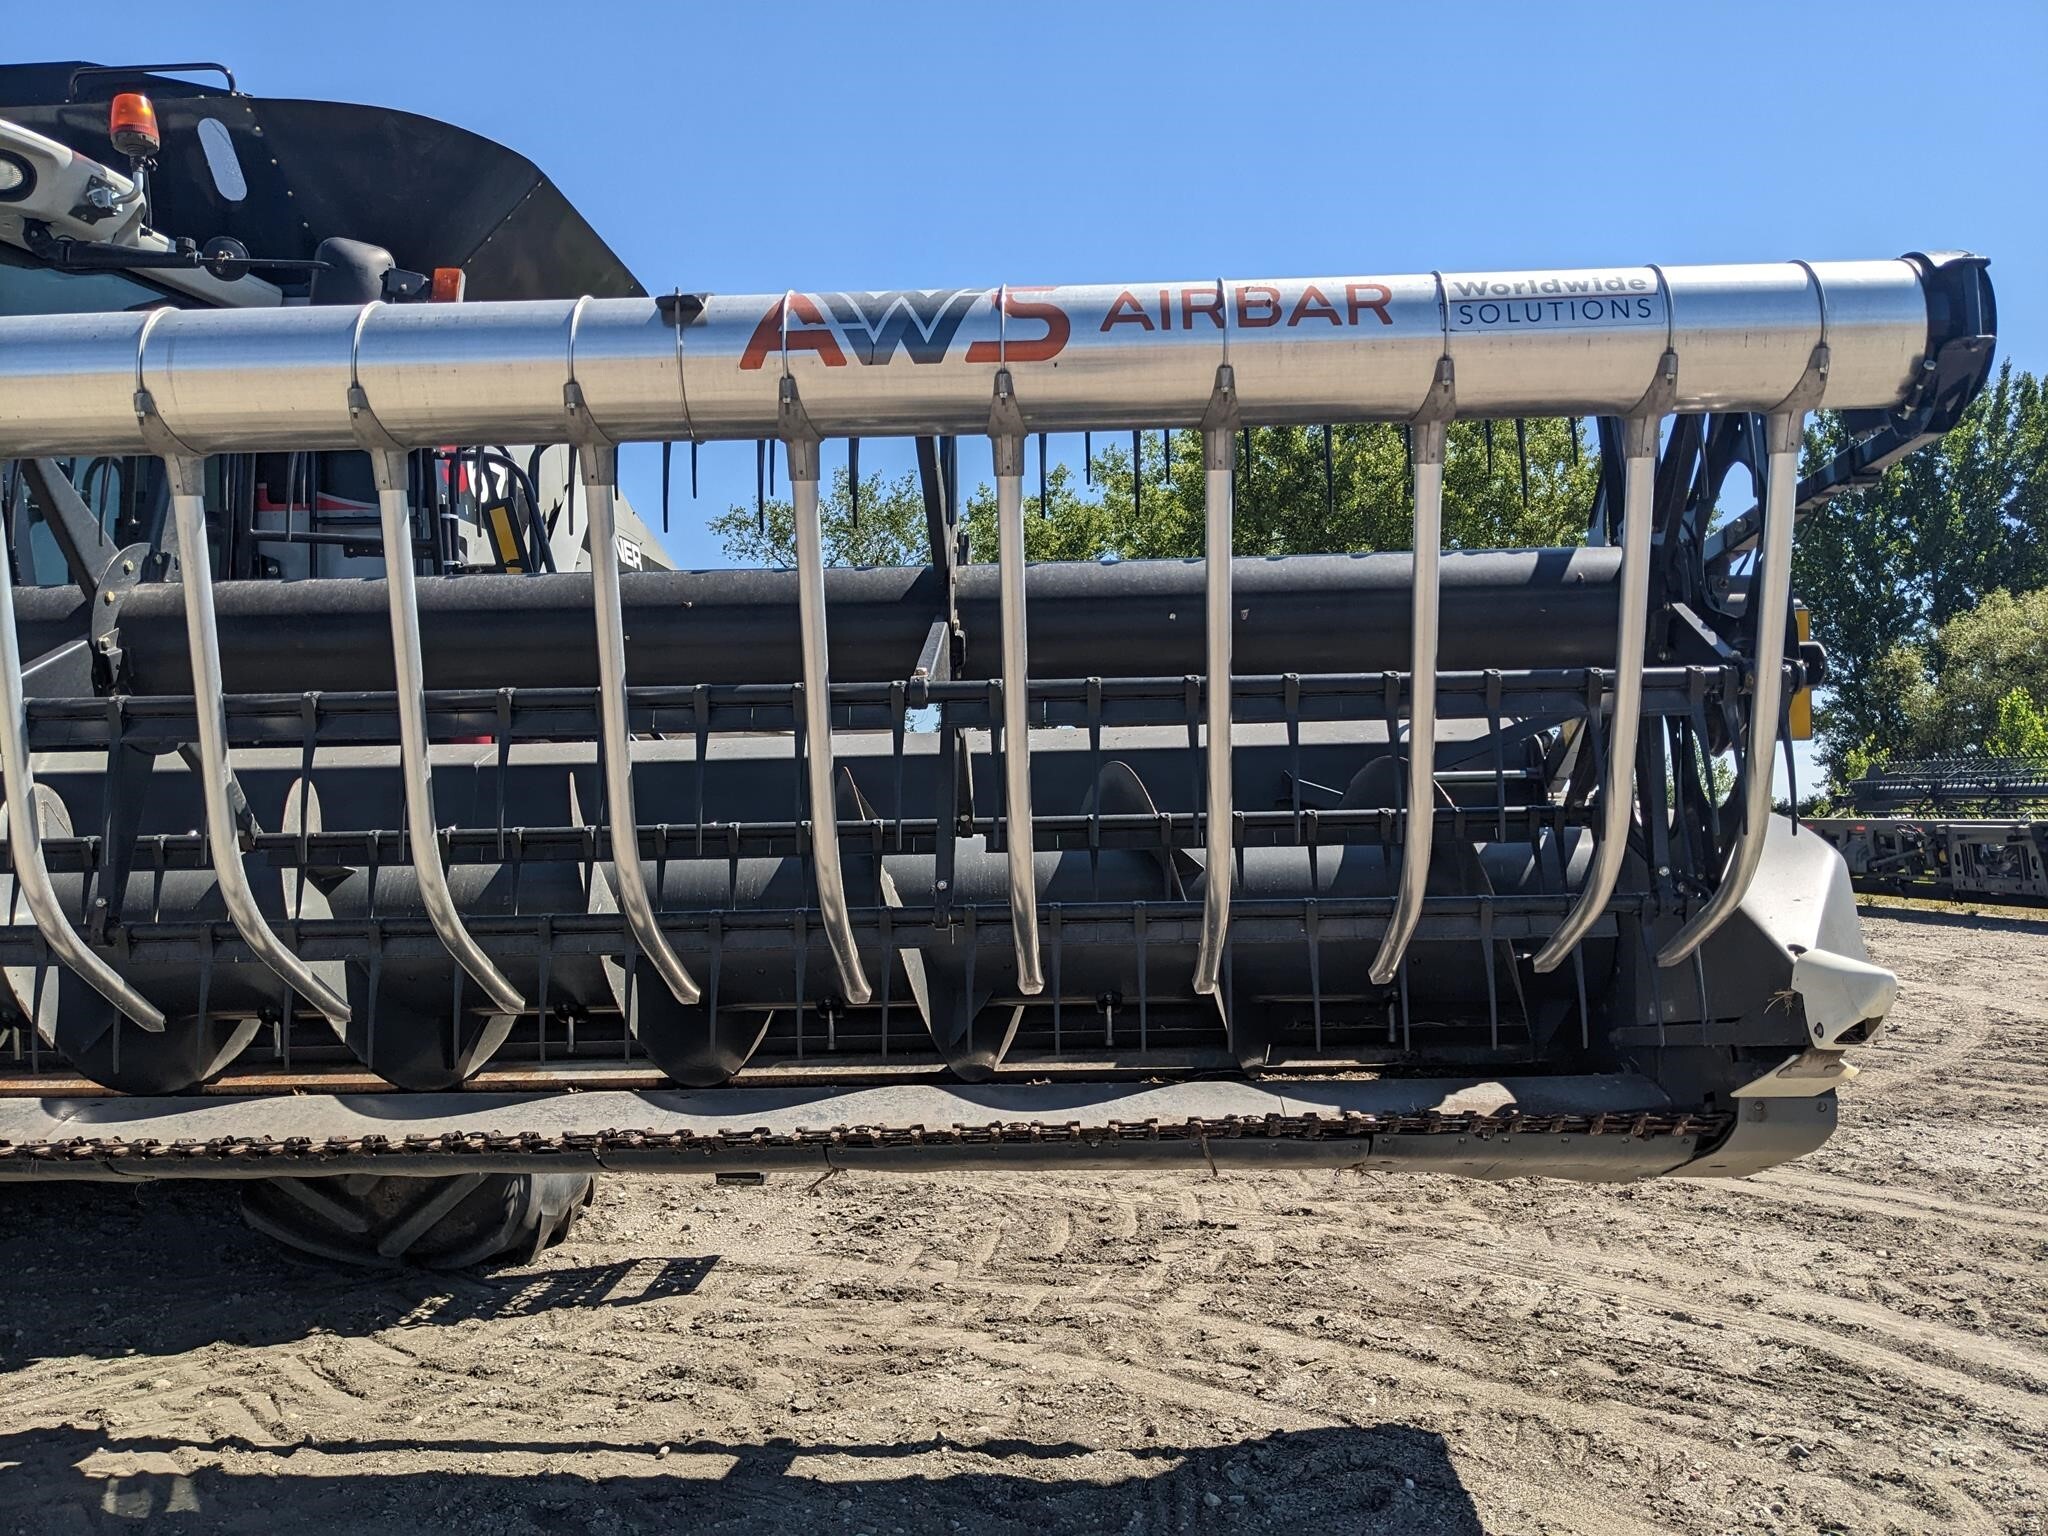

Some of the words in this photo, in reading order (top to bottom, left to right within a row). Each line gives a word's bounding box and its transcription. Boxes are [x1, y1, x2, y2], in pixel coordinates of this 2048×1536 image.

[1453, 276, 1647, 297] Worldwide
[1459, 298, 1652, 325] SOLUTIONS
[739, 287, 1071, 370] AWS
[1099, 284, 1393, 332] AIRBAR
